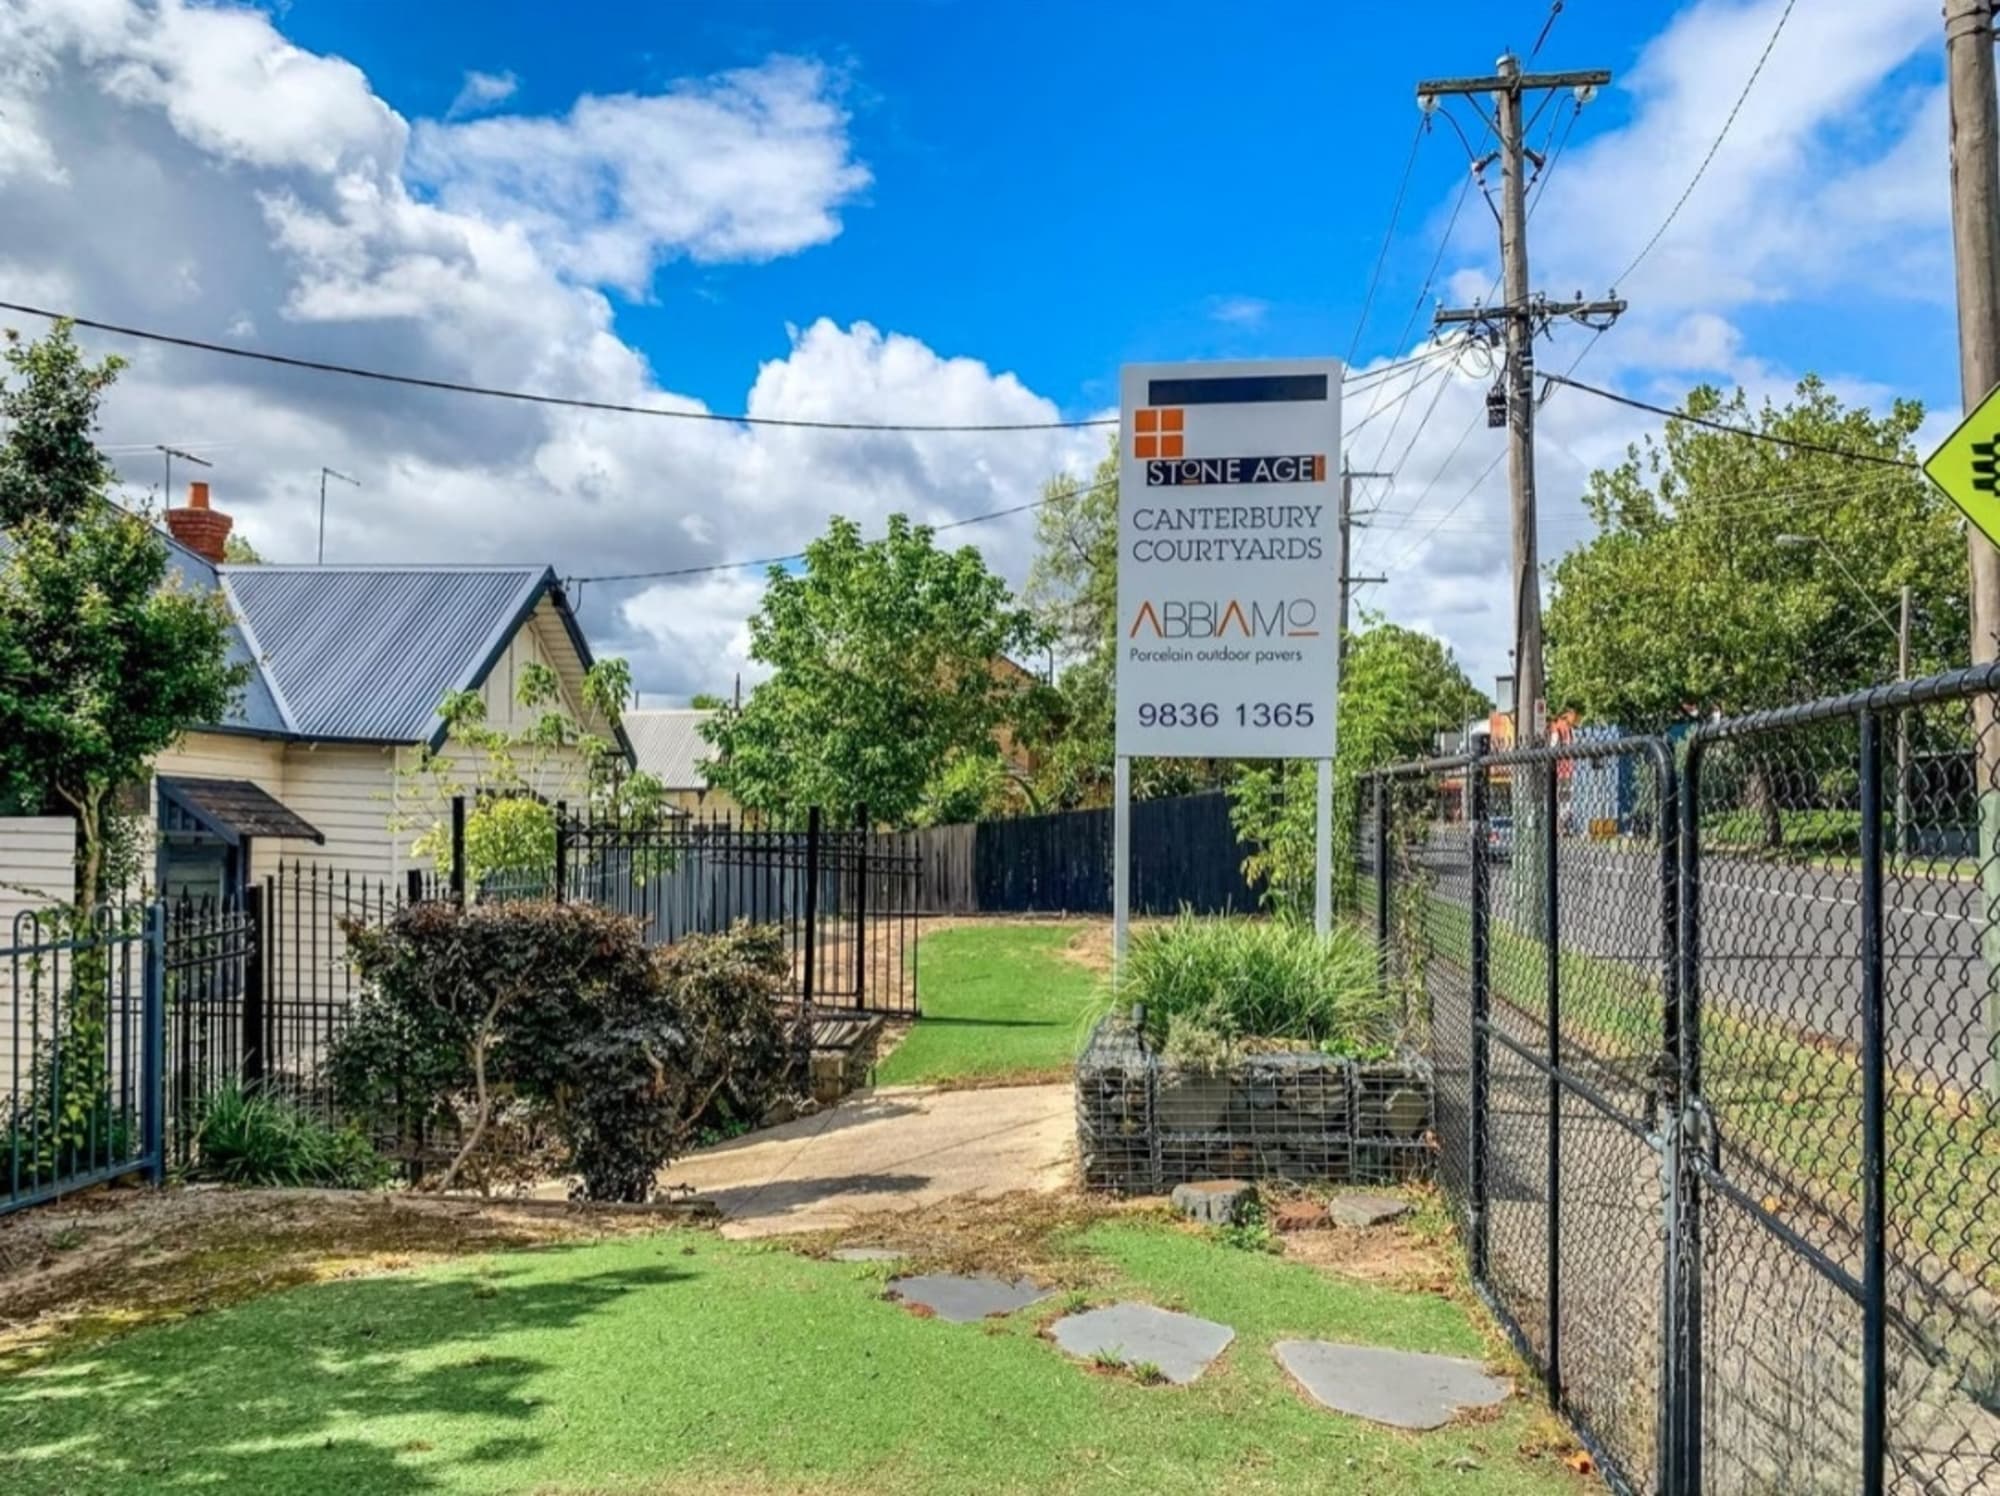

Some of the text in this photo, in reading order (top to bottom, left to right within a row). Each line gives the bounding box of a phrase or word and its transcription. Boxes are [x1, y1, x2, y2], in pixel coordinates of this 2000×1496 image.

[1149, 456, 1313, 485] STONE AGE
[1132, 505, 1323, 531] CANTERBURY
[1132, 537, 1323, 562] COURTYARDS
[1129, 645, 1303, 664] Porcelain outdoor pavers
[1138, 702, 1315, 728] 9836 1365
